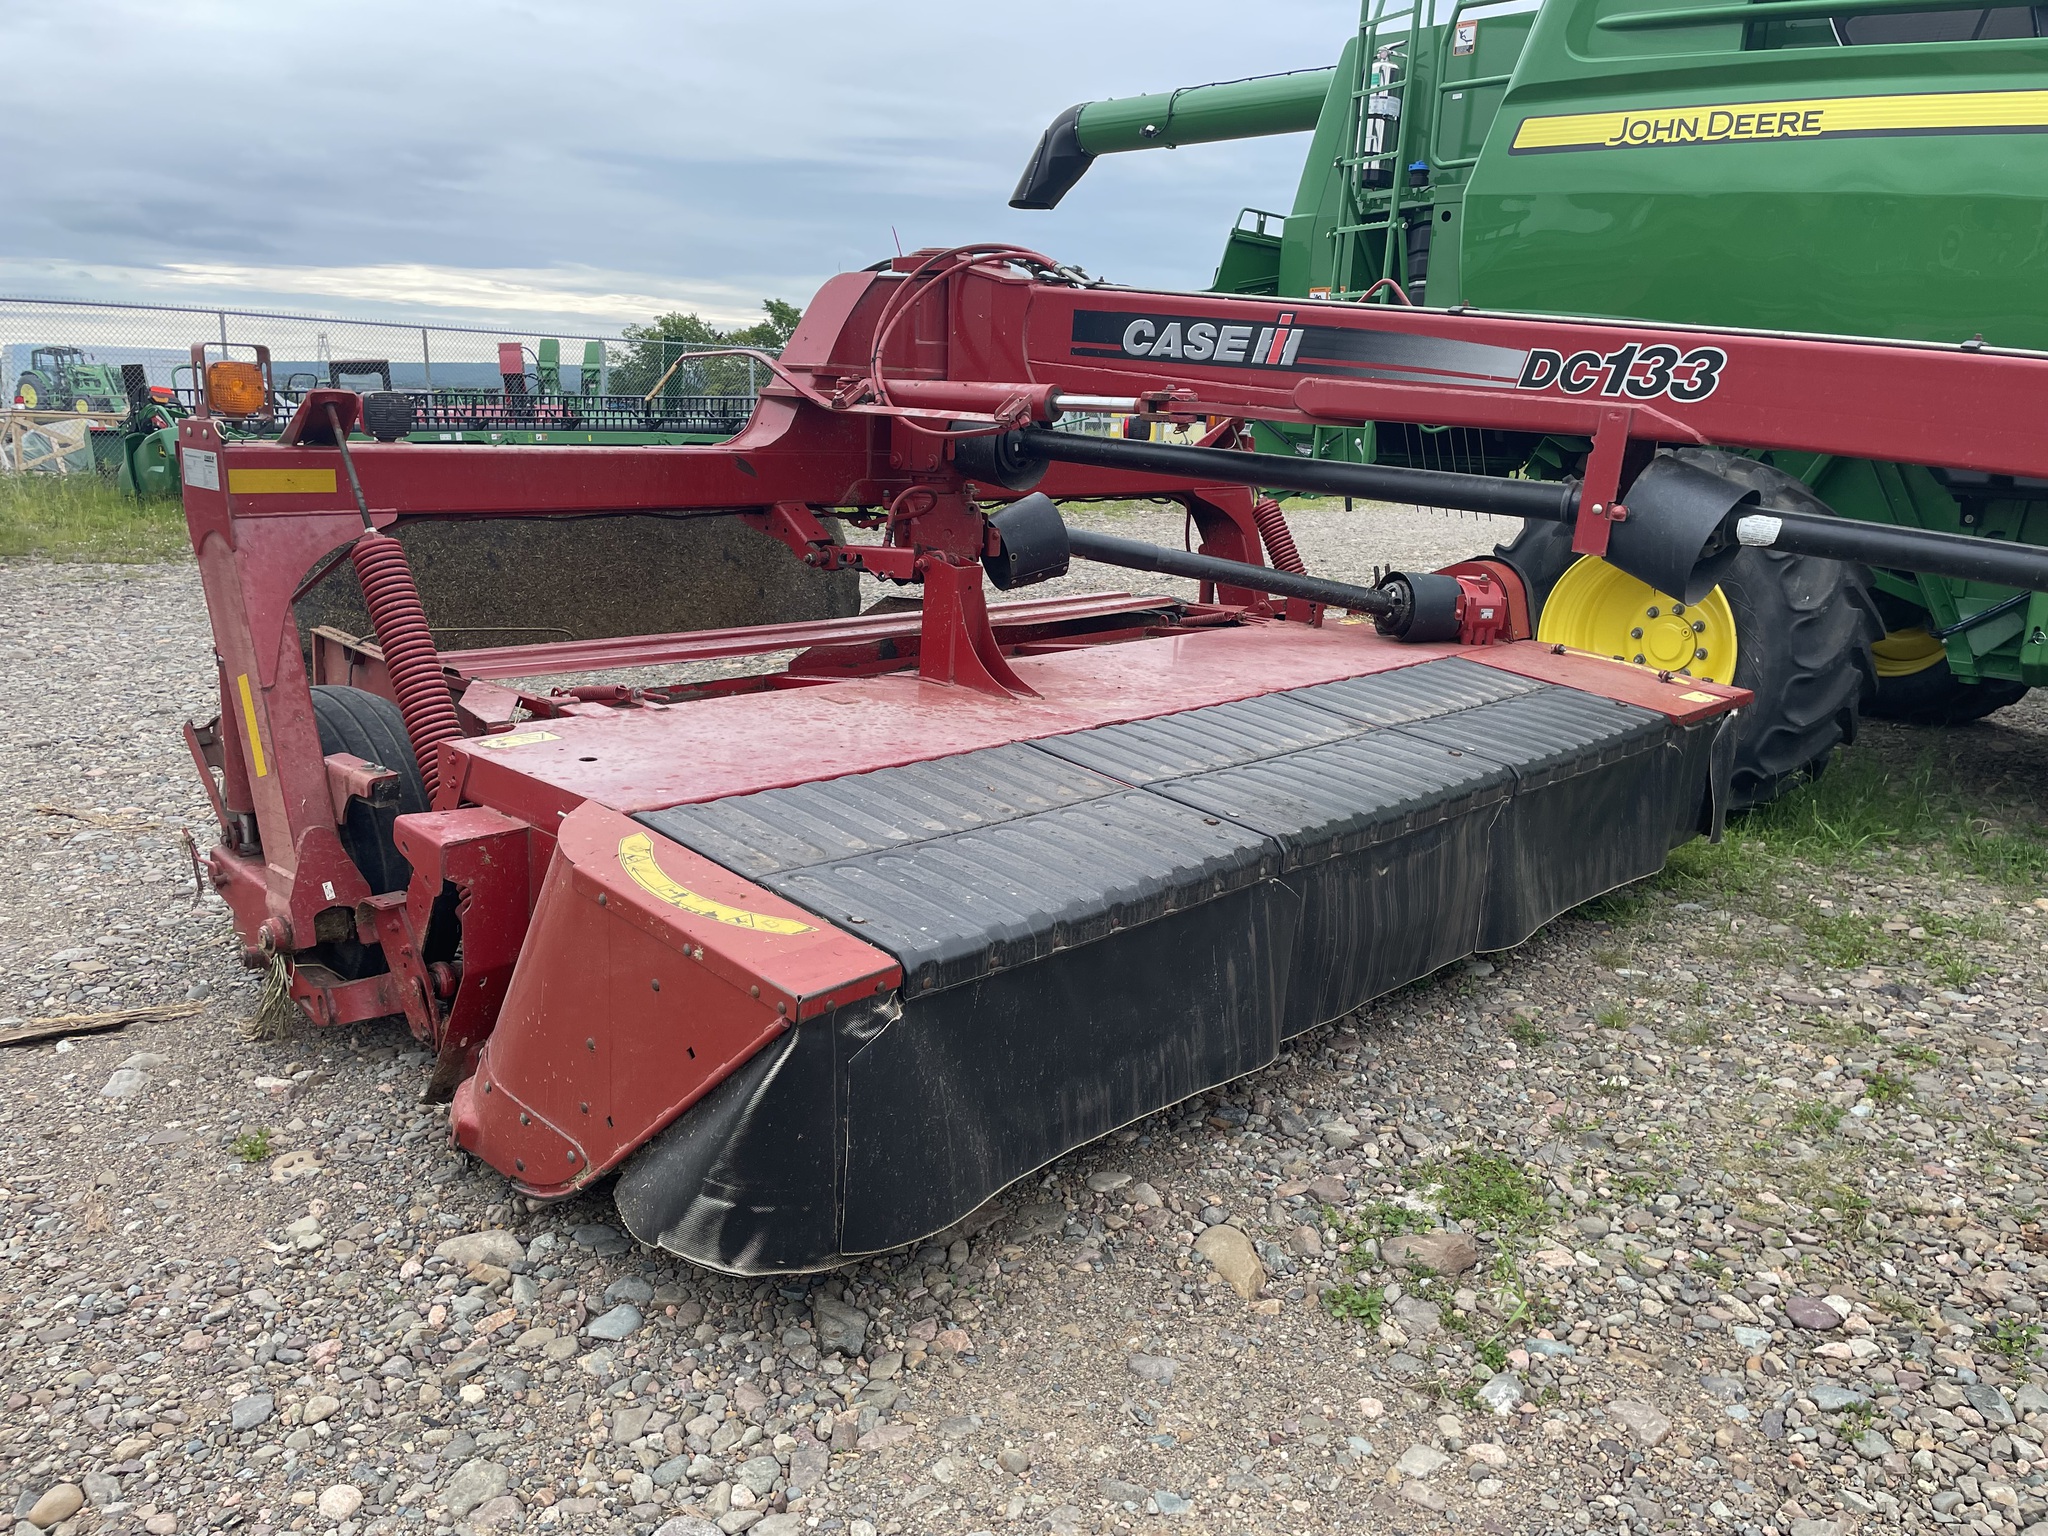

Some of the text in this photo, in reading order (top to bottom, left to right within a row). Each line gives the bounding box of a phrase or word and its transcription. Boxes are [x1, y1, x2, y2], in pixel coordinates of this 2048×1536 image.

[1609, 110, 1824, 142] JOHN DEERE
[1122, 319, 1253, 362] CASE
[1516, 343, 1728, 403] DC133
